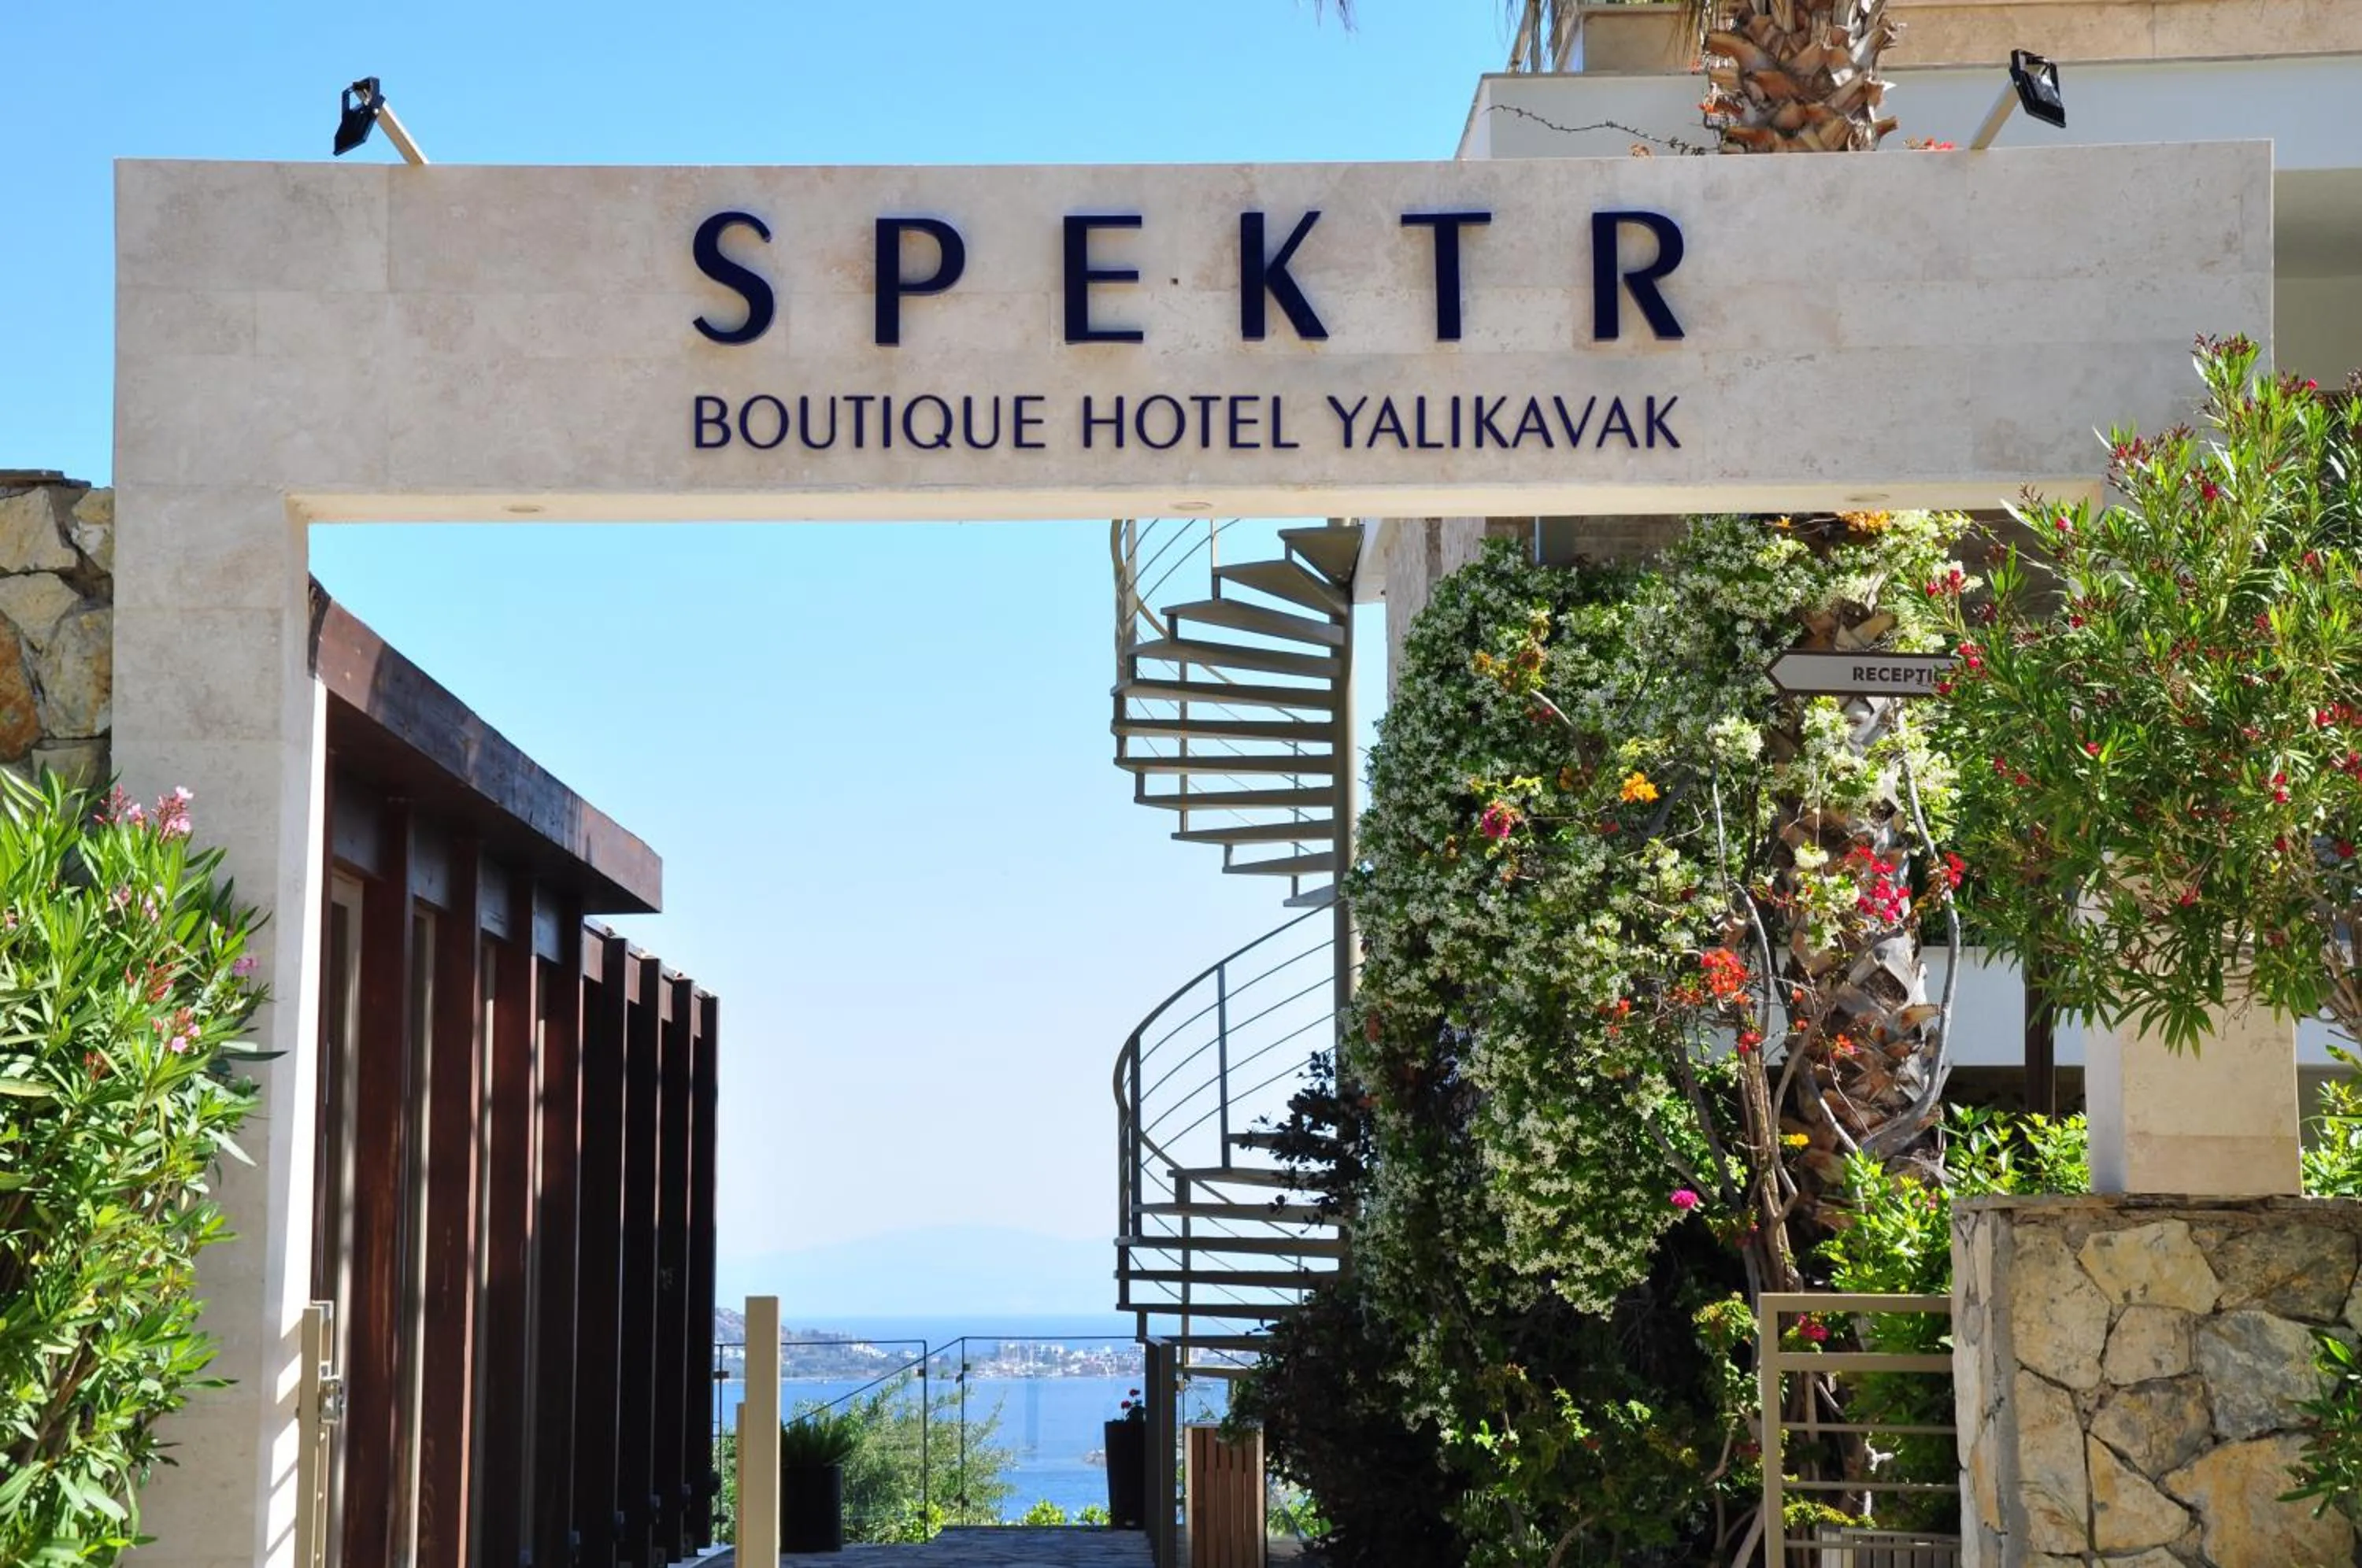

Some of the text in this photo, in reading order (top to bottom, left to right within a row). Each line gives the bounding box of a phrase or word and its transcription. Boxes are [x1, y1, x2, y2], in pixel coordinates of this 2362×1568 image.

[692, 210, 1686, 347] SPEKTR
[694, 394, 1681, 450] BOUTIQUE HOTEL YALIKAVAK
